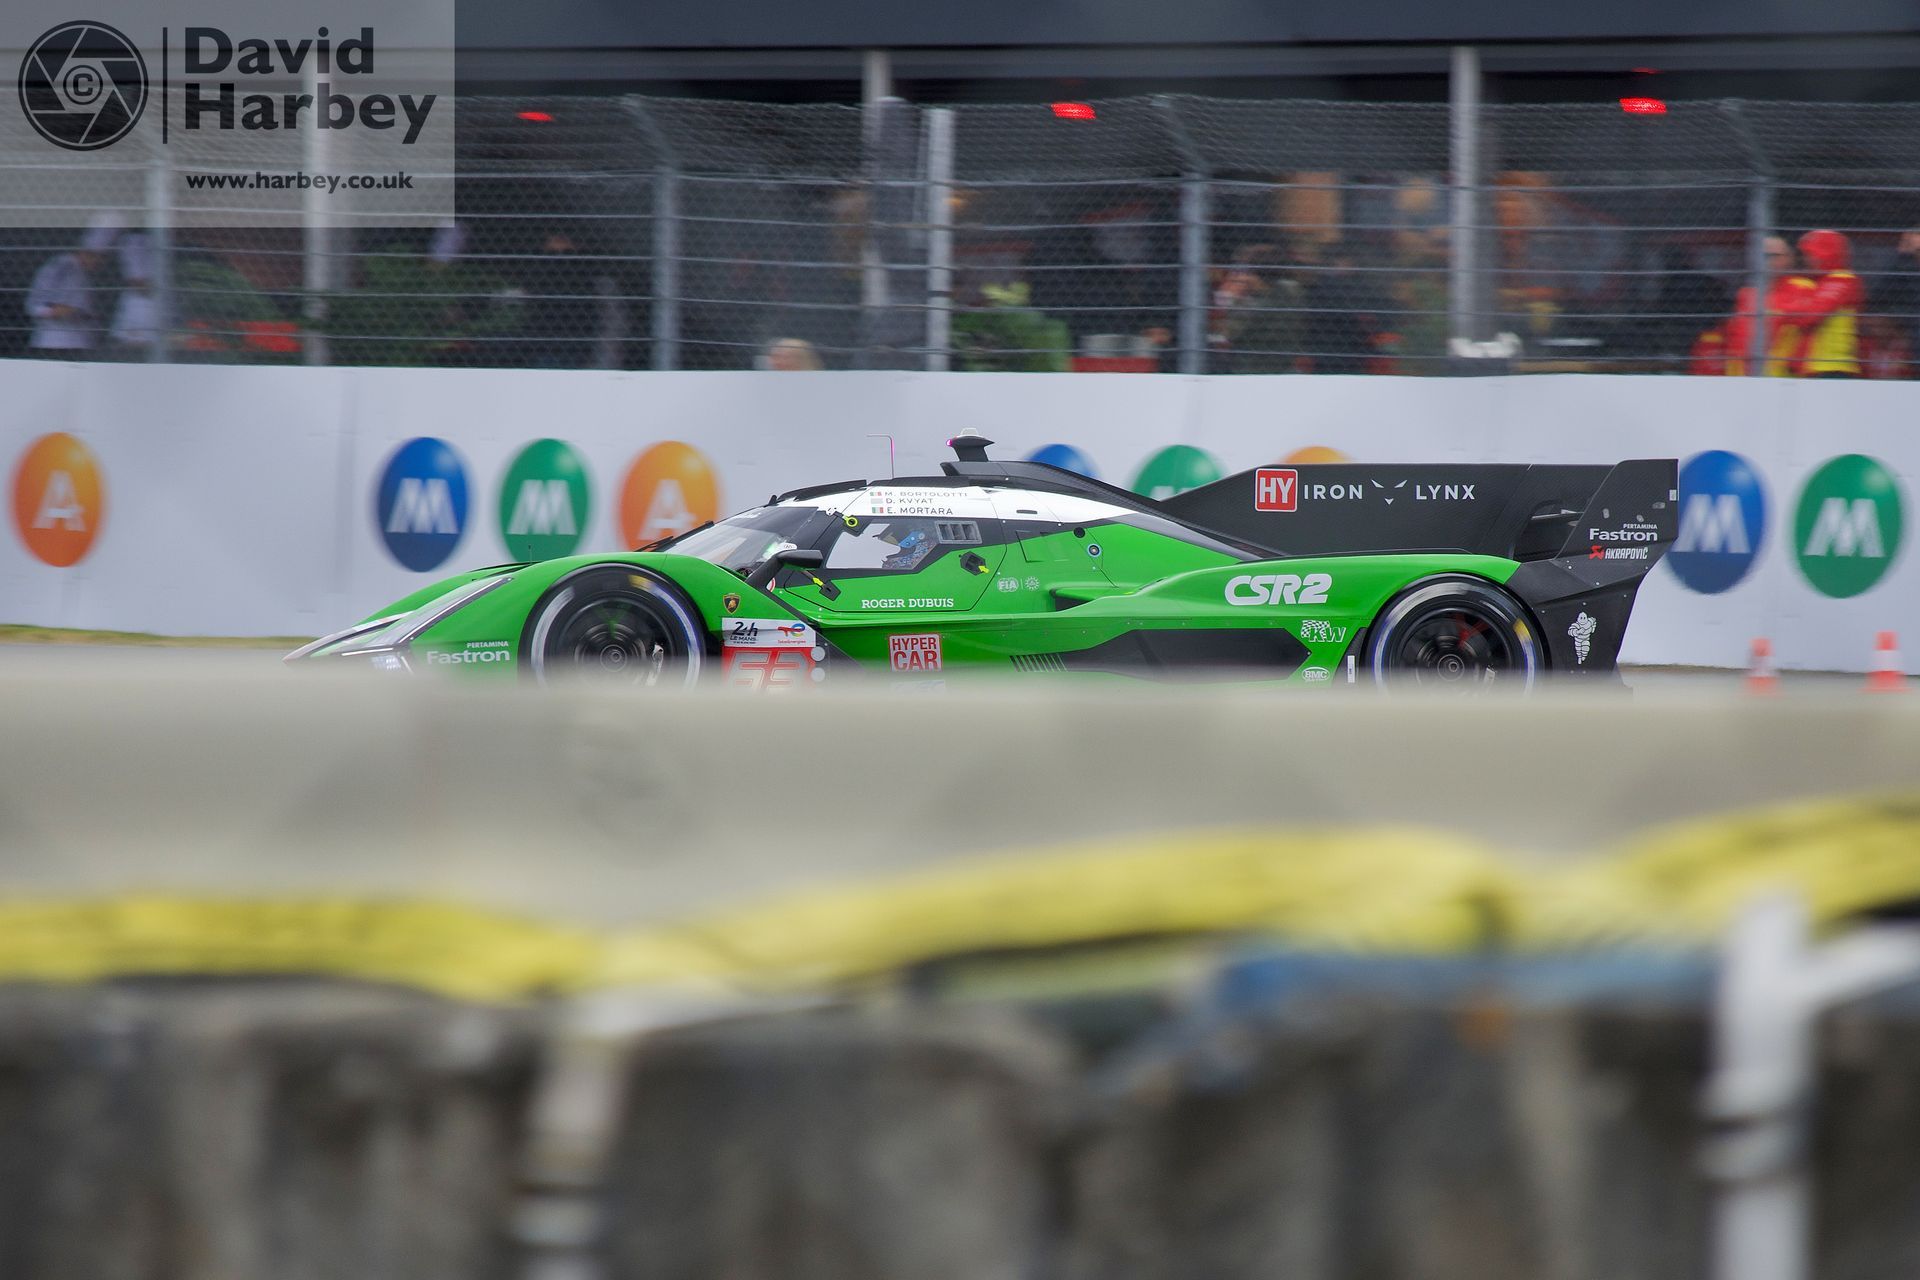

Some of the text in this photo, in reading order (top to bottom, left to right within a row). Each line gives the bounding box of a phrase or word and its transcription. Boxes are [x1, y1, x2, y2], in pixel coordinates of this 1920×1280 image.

[1259, 477, 1294, 504] HY
[1304, 484, 1475, 500] IRON LYNX
[900, 507, 953, 515] MORTARA
[1589, 528, 1658, 541] Fastron
[998, 580, 1018, 590] FIA
[1224, 573, 1332, 606] CSR2
[861, 598, 954, 609] ROGER DUBUIS
[1308, 626, 1347, 643] KW
[466, 641, 509, 649] PERTAMINA
[892, 637, 937, 650] HYPER
[426, 650, 510, 664] Fastron
[893, 650, 938, 671] CAR
[1304, 671, 1328, 680] BMC
